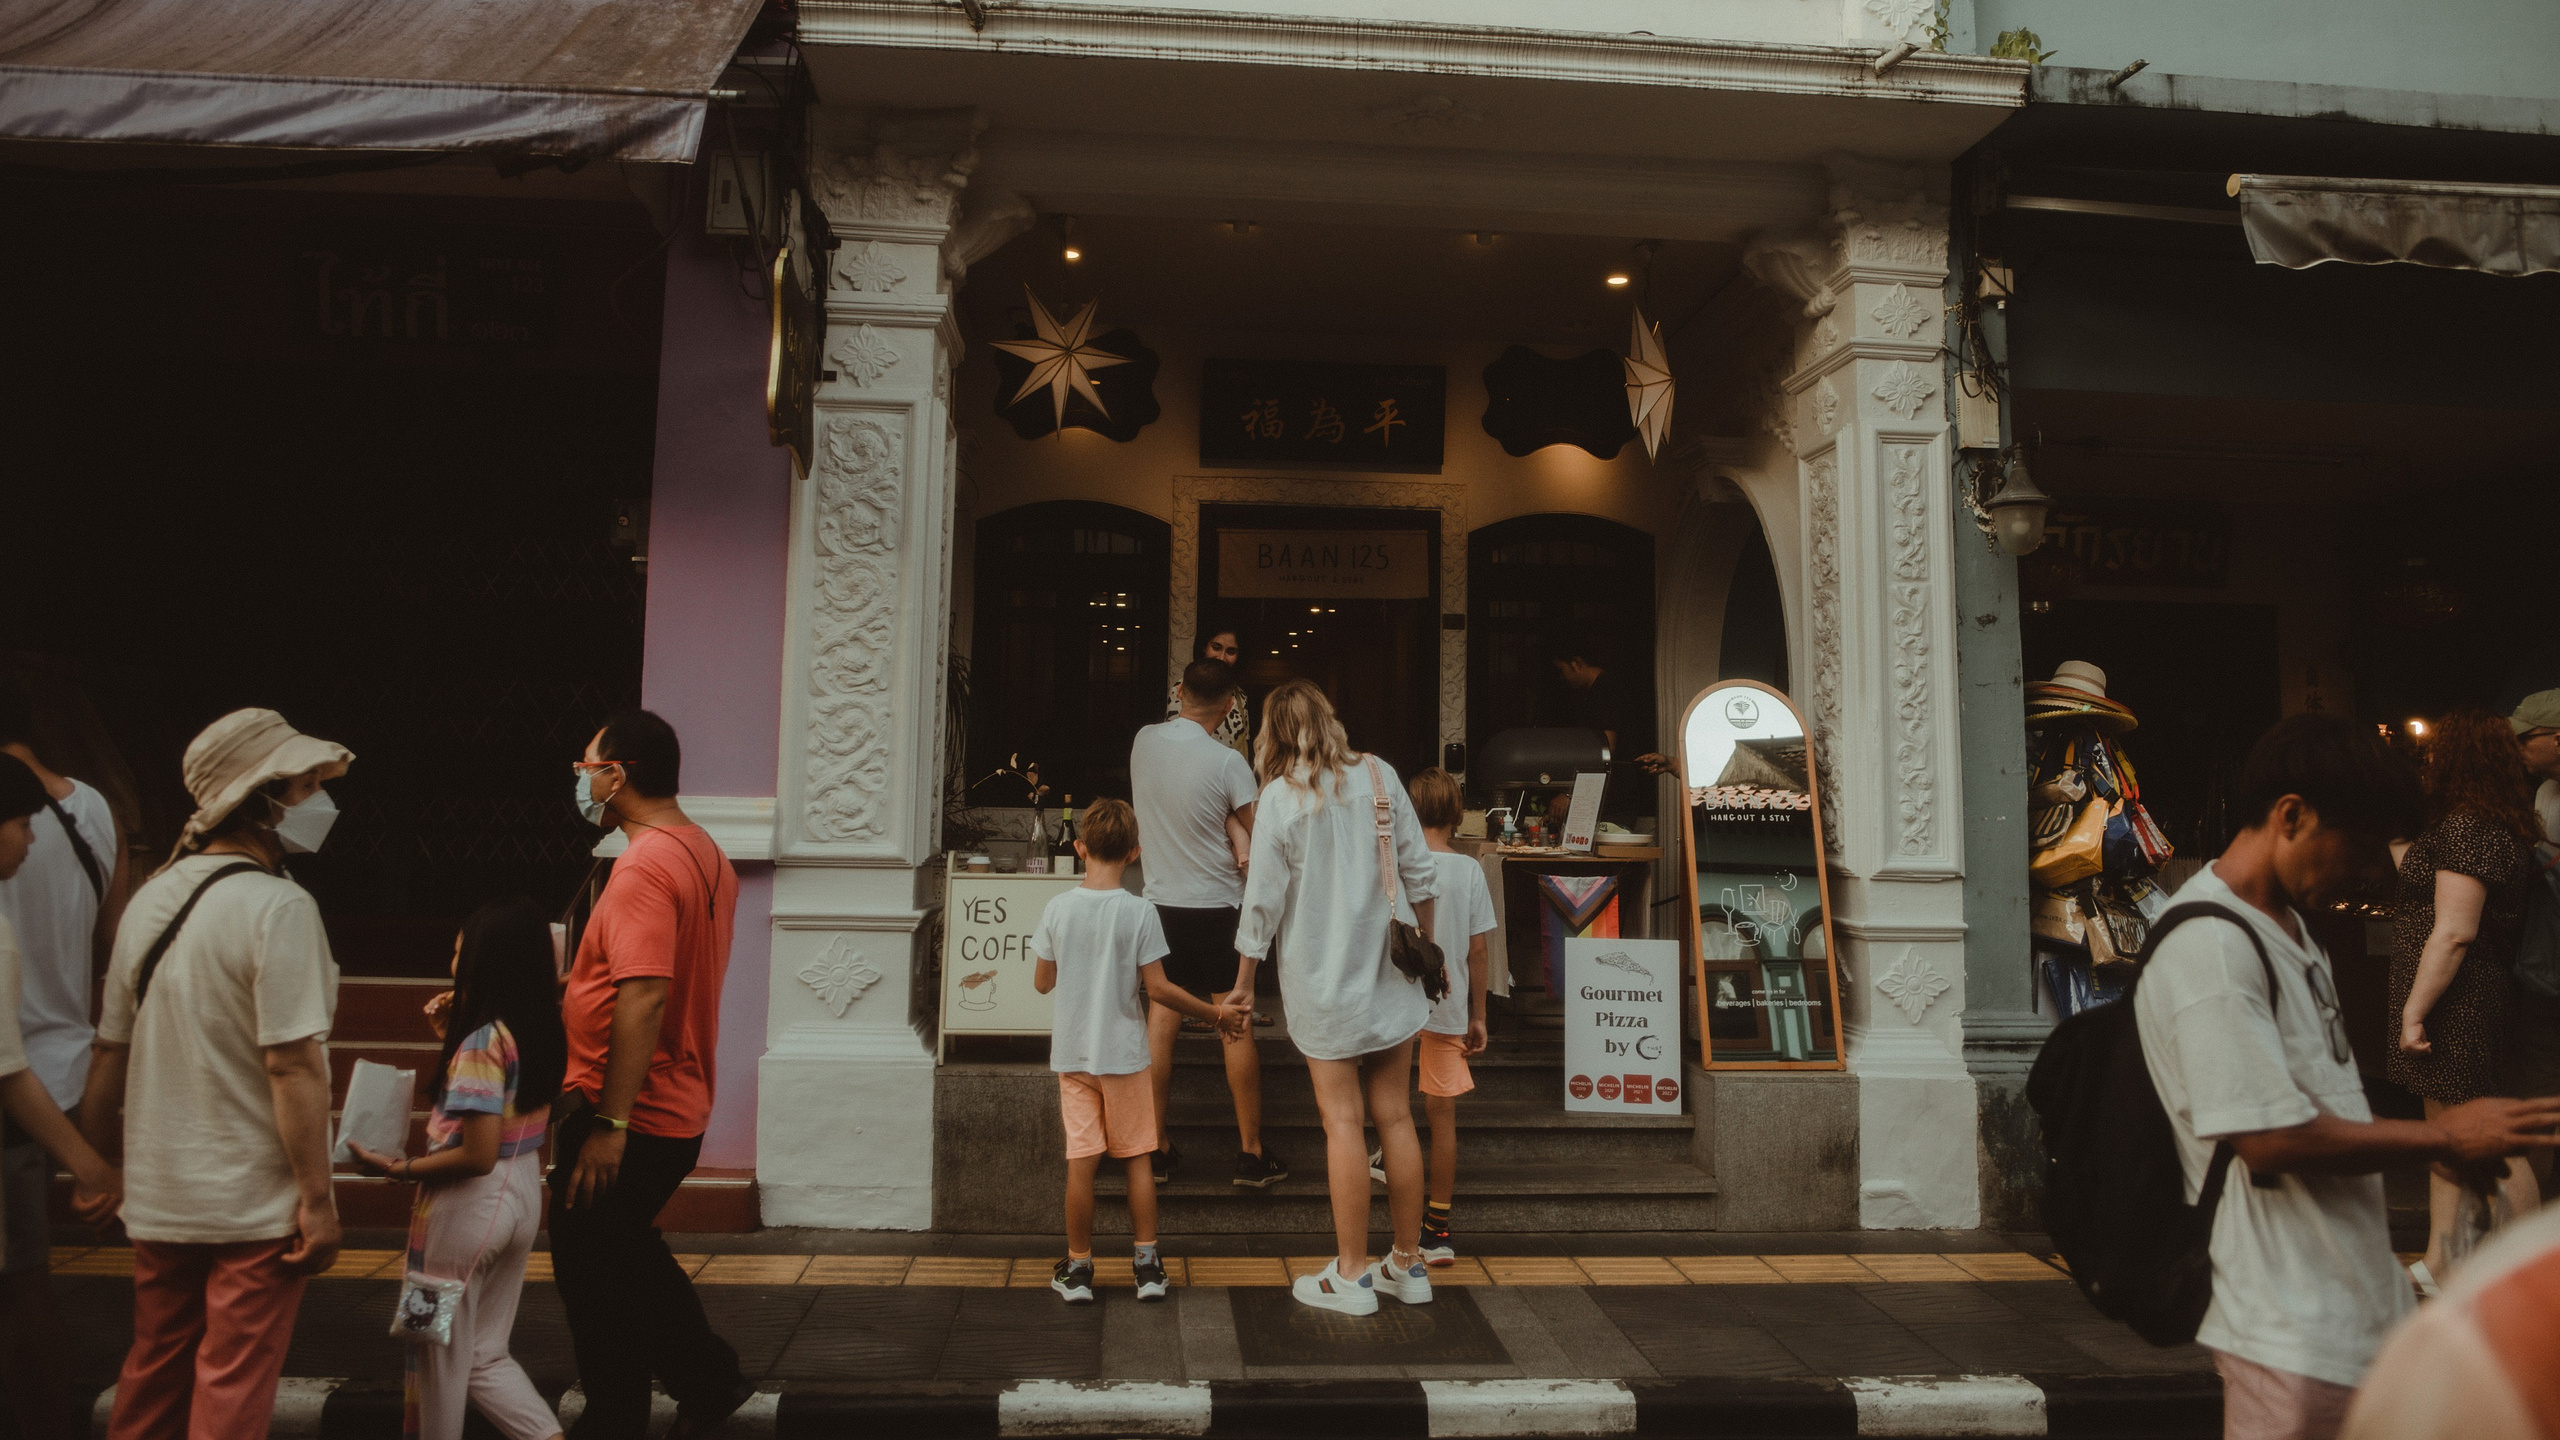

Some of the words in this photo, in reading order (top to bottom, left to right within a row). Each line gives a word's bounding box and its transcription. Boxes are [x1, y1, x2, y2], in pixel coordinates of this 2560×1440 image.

[511, 275, 545, 293] 123
[1257, 543, 1339, 570] BAAN
[1352, 544, 1390, 570] 125
[1705, 792, 1761, 810] BAAN
[1769, 793, 1796, 811] 125
[1710, 813, 1755, 822] HANGOUT
[1769, 814, 1791, 822] STAY
[963, 896, 1007, 924] YES
[1580, 985, 1663, 1003] Gourmet
[1717, 999, 1751, 1008] beverages
[1756, 999, 1784, 1007] bakeries
[1788, 999, 1822, 1007] bedrooms
[1595, 1012, 1648, 1028] Pizza
[1605, 1038, 1630, 1057] by
